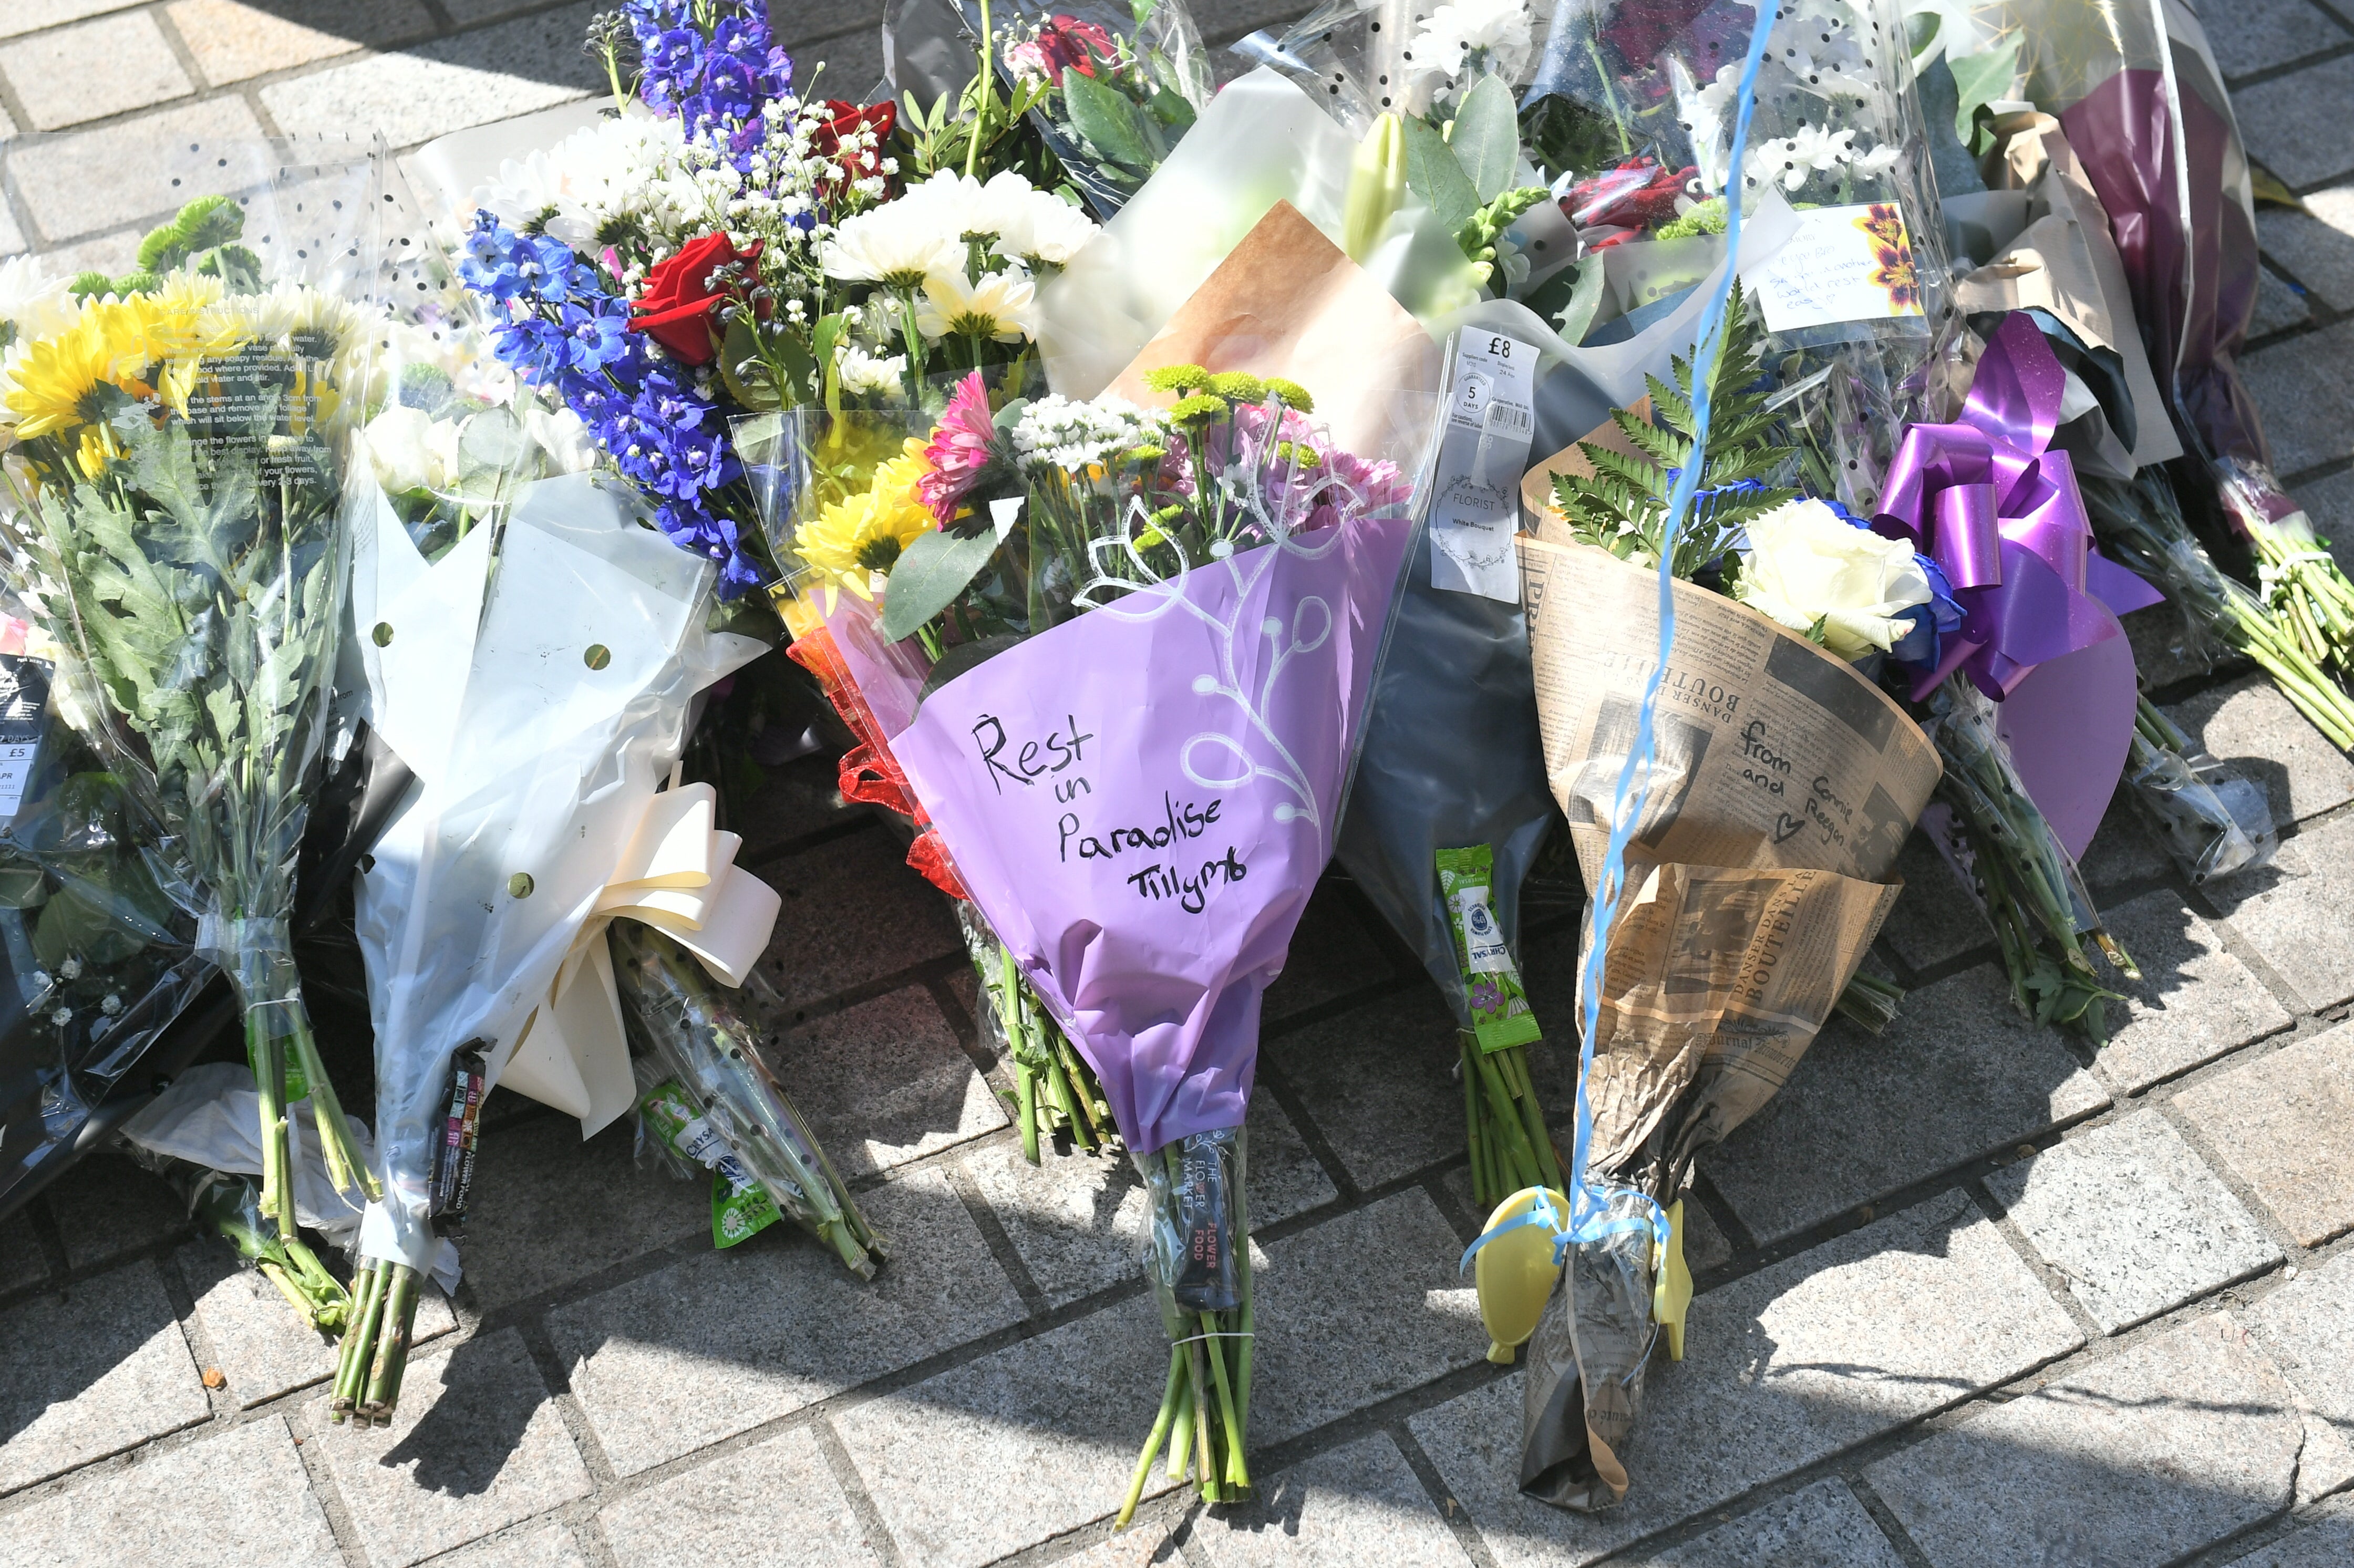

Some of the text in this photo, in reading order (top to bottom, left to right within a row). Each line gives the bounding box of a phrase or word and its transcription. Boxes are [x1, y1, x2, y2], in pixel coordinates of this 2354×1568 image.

[1488, 337, 1511, 358] £8
[207, 356, 222, 365] any
[224, 355, 250, 364] soapy
[243, 364, 282, 373] provided.
[1463, 374, 1486, 386] GUARANTEED
[190, 396, 204, 405] the
[206, 395, 233, 404] stems
[303, 394, 322, 403] from
[1468, 386, 1477, 399] 5
[228, 404, 260, 412] remove
[278, 403, 307, 413] foliage
[1463, 401, 1479, 410] DAYS
[171, 416, 197, 426] which
[198, 416, 213, 425] will
[214, 415, 225, 424] sit
[226, 414, 252, 423] below
[210, 437, 224, 445] the
[225, 435, 256, 445] flowers
[210, 447, 230, 457] best
[271, 455, 293, 464] fresh
[294, 454, 313, 463] fruit.
[264, 467, 284, 476] your
[284, 466, 318, 475] flowers,
[293, 476, 317, 487] days.
[1453, 493, 1495, 511] FLORIST
[1452, 518, 1495, 532] White Bouquet
[337, 690, 354, 701] from
[1672, 689, 1731, 724] DANSER
[8, 748, 26, 757] £5
[1740, 720, 1791, 774] from
[972, 714, 1094, 796] Rest
[1051, 775, 1092, 803] in
[1742, 768, 1784, 797] and
[1058, 790, 1222, 863] Paradise
[1458, 876, 1486, 885] UNIVERSAL
[1733, 934, 1764, 994] DANSER
[1761, 890, 1787, 928] DANS
[1744, 869, 1816, 1002] BOUTEILLE
[1471, 946, 1506, 960] CHRYSAL
[1207, 1161, 1217, 1183] THE
[455, 1151, 471, 1209] FLOWER FOOD
[1183, 1160, 1194, 1209] MARKET
[1194, 1229, 1205, 1261] FOOD
[1206, 1223, 1217, 1269] FLOWER
